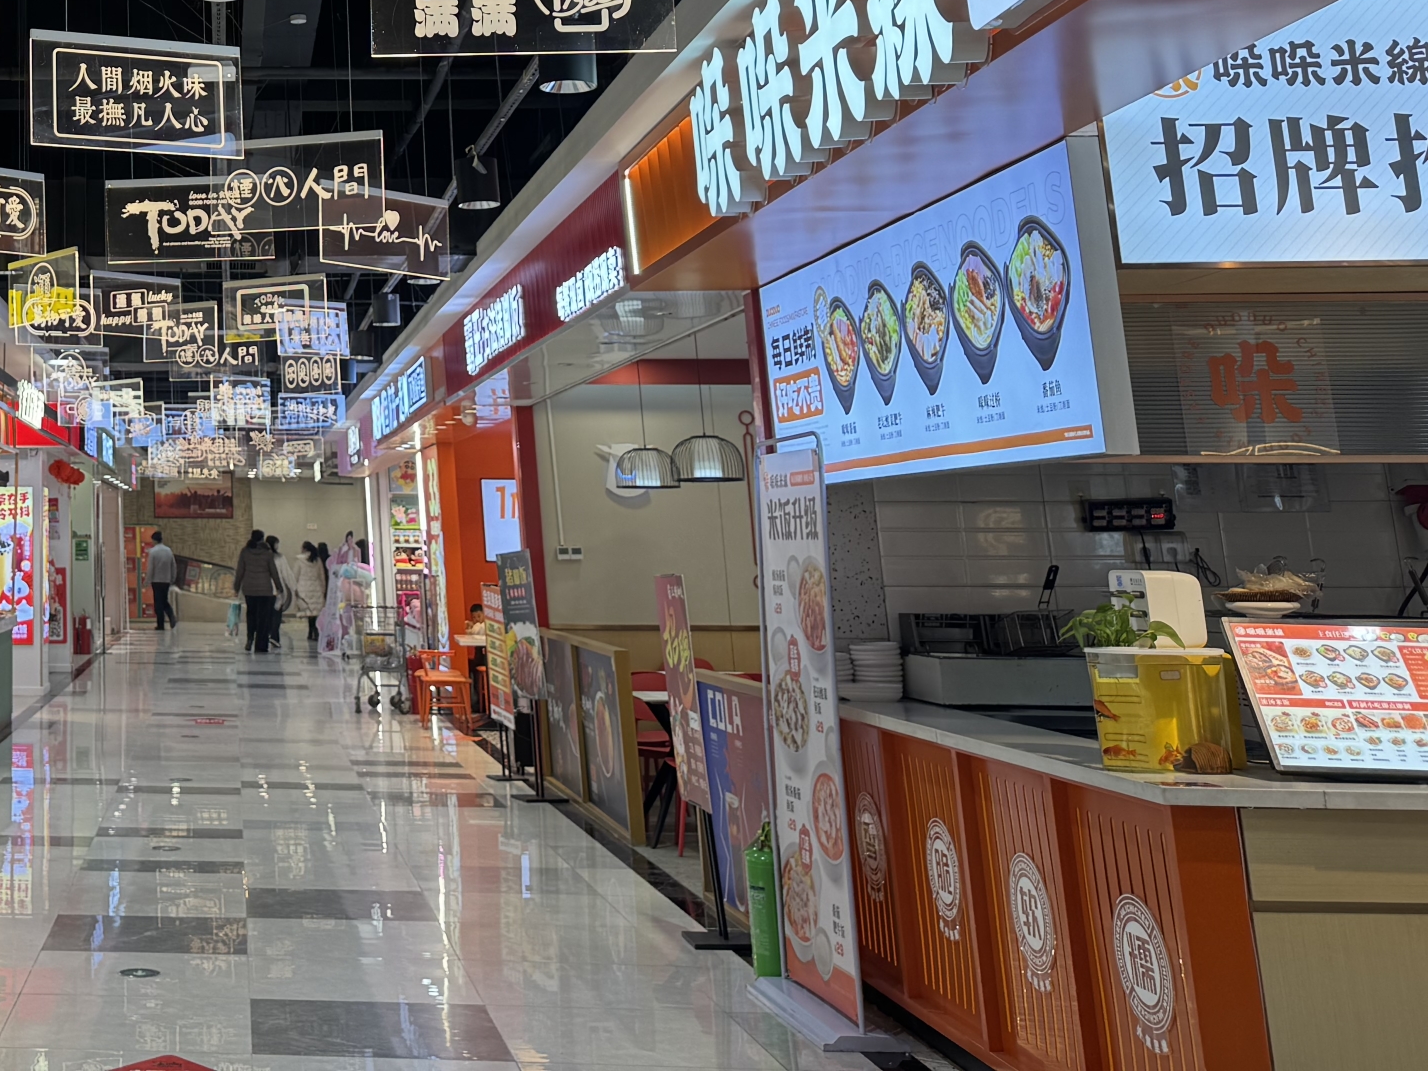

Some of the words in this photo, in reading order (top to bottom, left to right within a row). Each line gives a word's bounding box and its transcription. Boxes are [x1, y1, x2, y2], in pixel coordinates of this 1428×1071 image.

[69, 62, 209, 100] 人間烟火味
[71, 96, 210, 132] 最撫凡人心
[101, 313, 131, 326] happy
[1207, 339, 1303, 423] 哚
[767, 496, 819, 541] 米饭升级
[707, 689, 743, 737] COLA
[934, 847, 953, 896] 脆
[1018, 884, 1043, 941] 软
[1125, 930, 1158, 996] 糯
